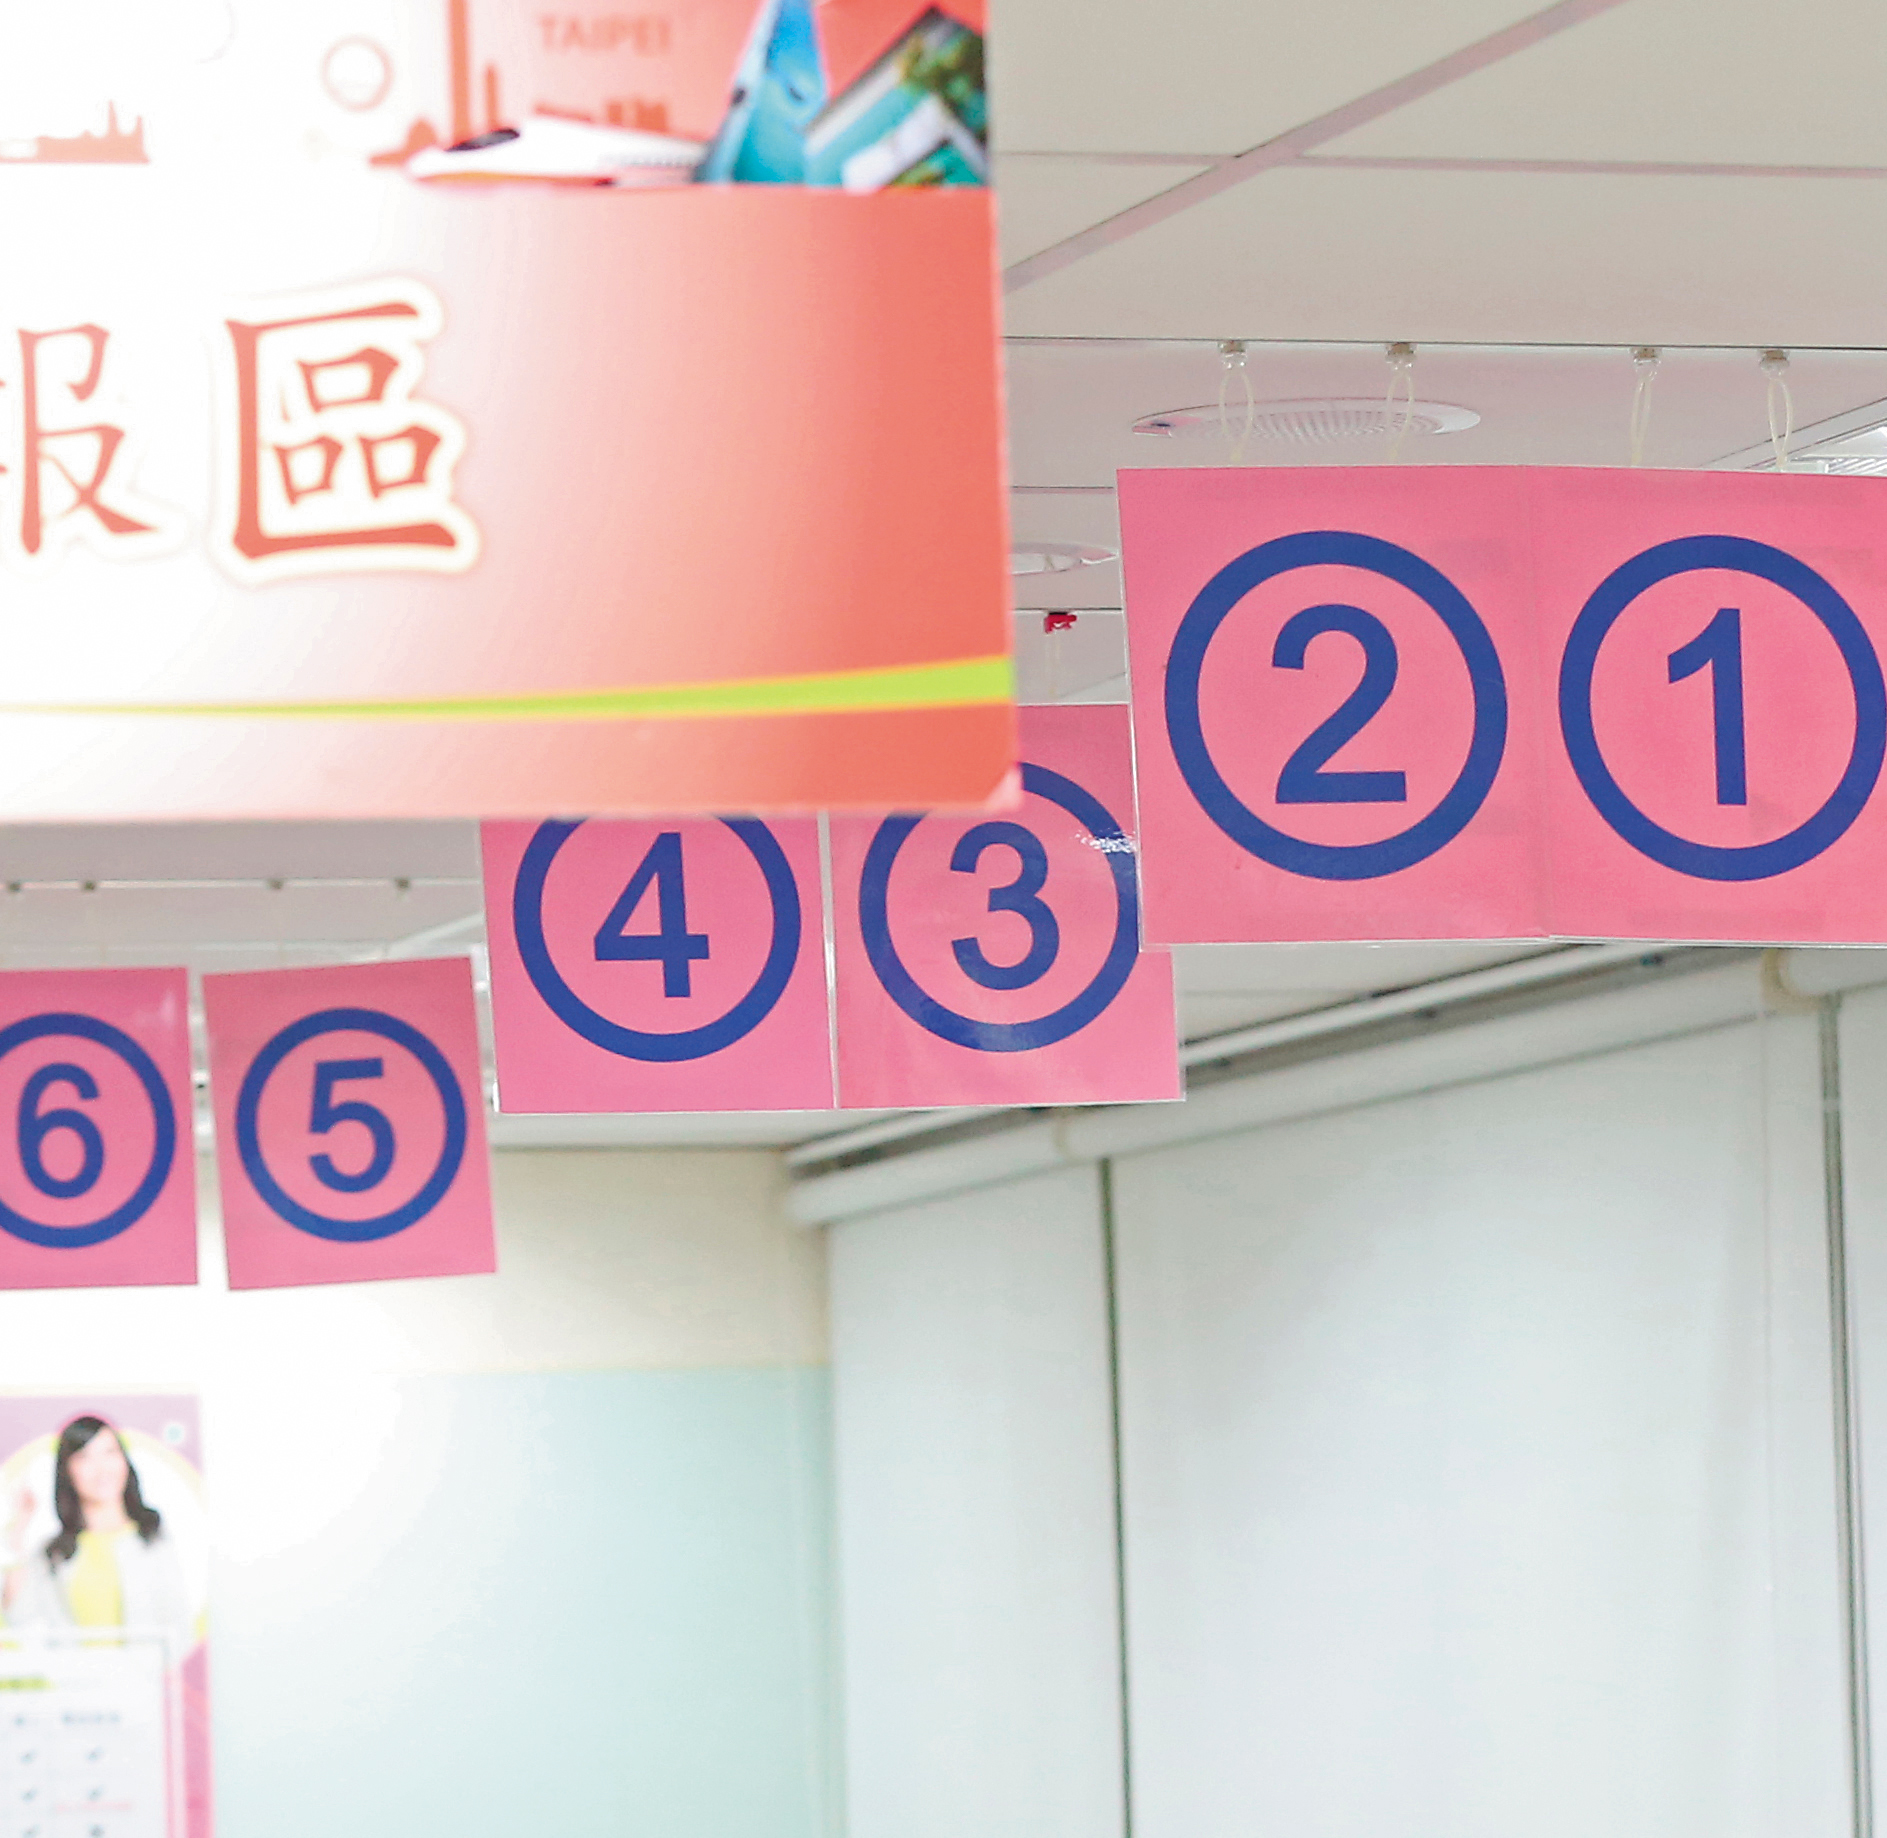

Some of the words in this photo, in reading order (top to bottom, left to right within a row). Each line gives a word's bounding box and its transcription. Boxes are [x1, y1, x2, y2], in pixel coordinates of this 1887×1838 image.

[540, 15, 672, 54] TAIPEI
[1269, 602, 1409, 806] 2
[1666, 607, 1748, 808] 1
[593, 831, 711, 999] 4
[950, 820, 1061, 991] 3
[15, 1061, 106, 1200] 6
[307, 1057, 399, 1194] 5
